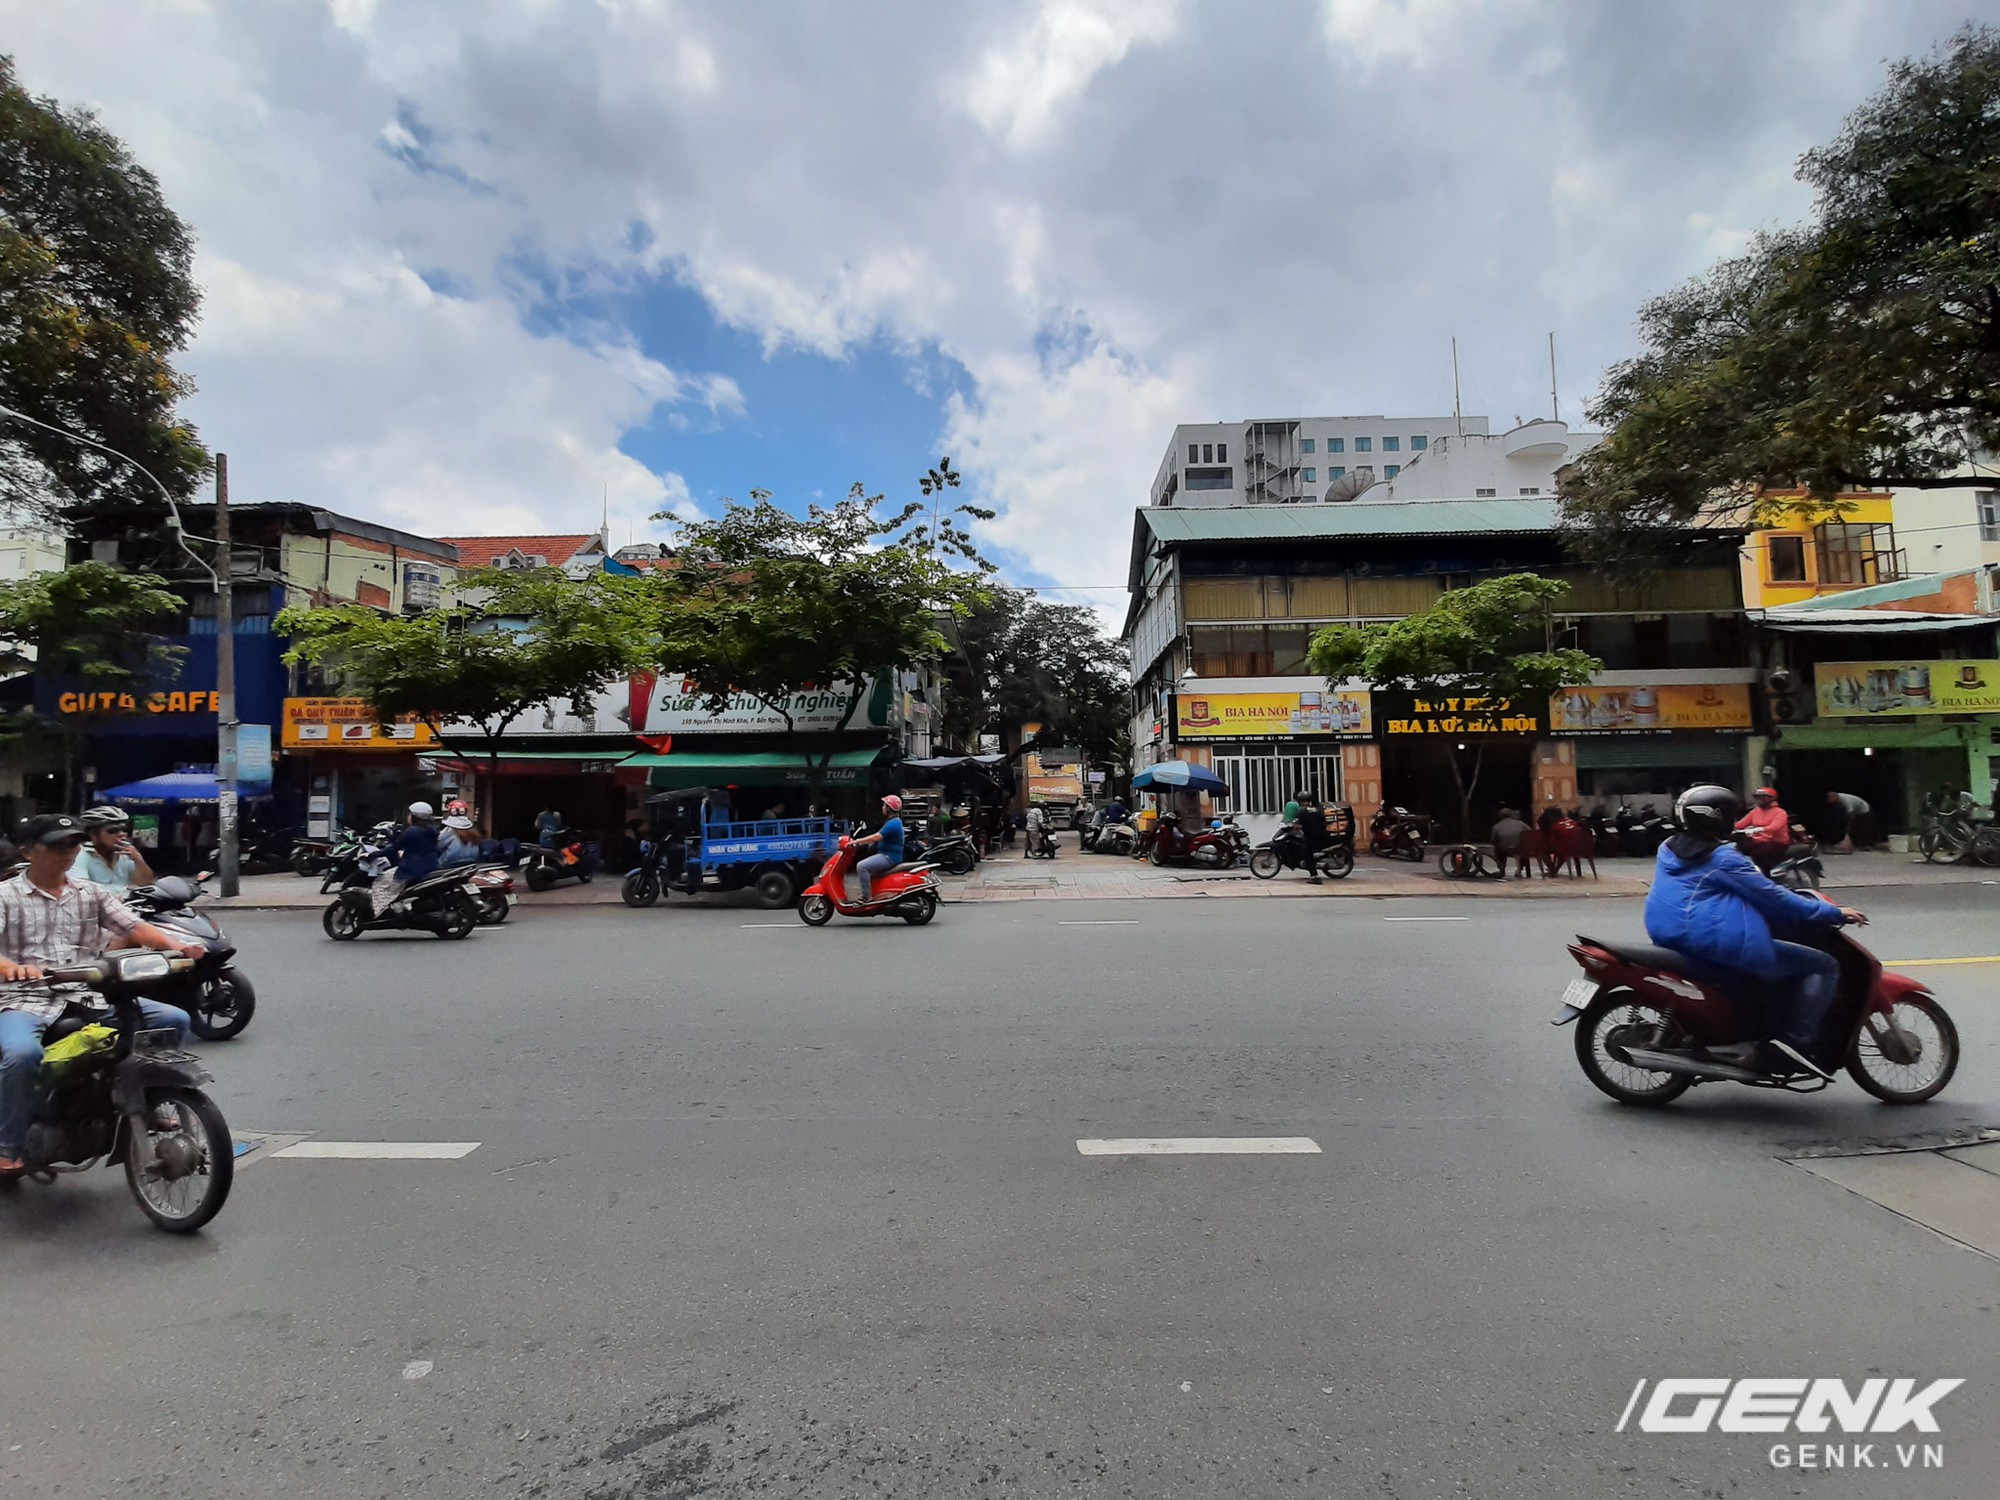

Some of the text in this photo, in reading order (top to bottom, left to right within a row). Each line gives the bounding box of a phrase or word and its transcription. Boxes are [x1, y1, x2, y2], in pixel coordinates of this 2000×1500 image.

[699, 696, 723, 712] x
[1225, 707, 1246, 717] BIA
[1387, 718, 1424, 734] BIA
[1501, 713, 1538, 736] NỘI
